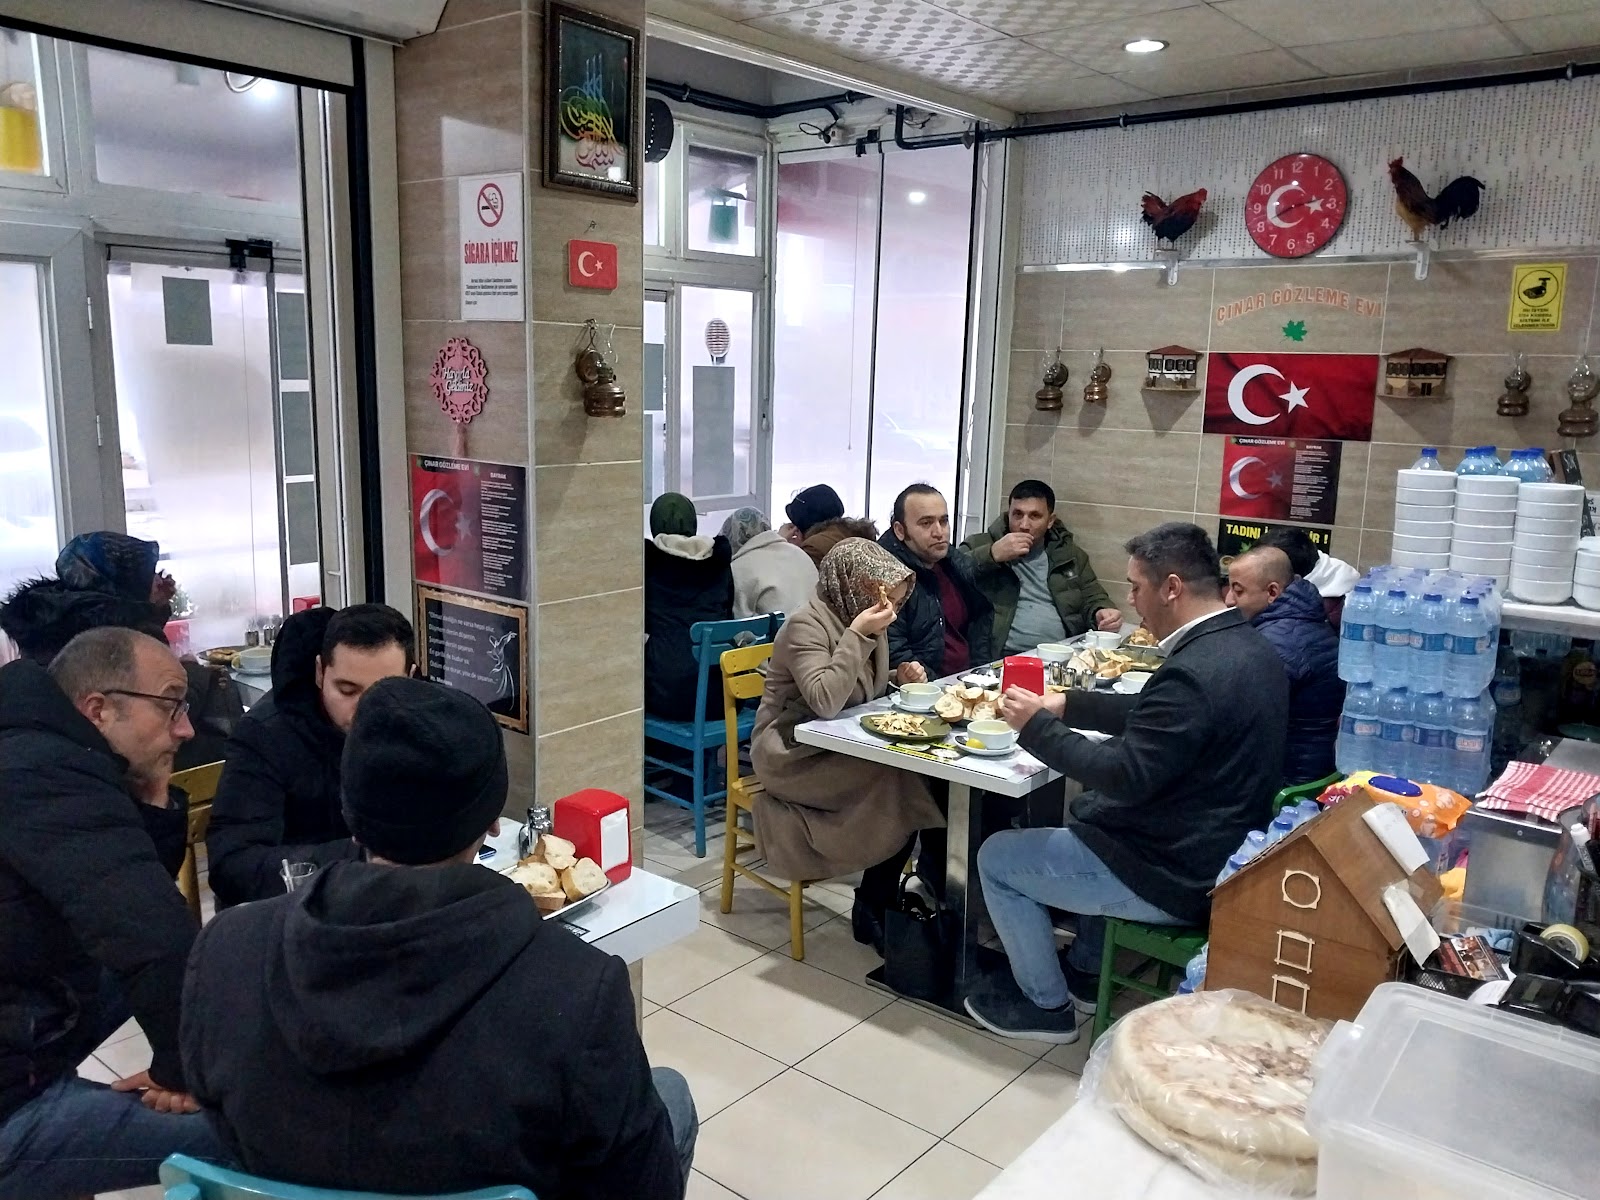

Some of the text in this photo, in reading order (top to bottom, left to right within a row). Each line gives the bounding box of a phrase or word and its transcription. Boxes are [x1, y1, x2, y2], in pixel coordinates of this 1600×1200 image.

[1292, 162, 1303, 173] 12
[1314, 166, 1319, 176] 1
[1274, 168, 1284, 179] 11
[1260, 184, 1271, 195] 10
[1324, 179, 1333, 190] 2
[1253, 203, 1262, 214] 9
[1328, 198, 1337, 209] 3
[1257, 222, 1265, 232] 8
[1321, 218, 1330, 229] 4
[1269, 235, 1277, 245] 7
[1306, 233, 1315, 243] 5
[1287, 239, 1295, 250] 6
[464, 239, 518, 266] SİGARA İÇİLMEZ
[1216, 292, 1265, 326] ÇINAR
[1272, 283, 1349, 309] GÖZLEME
[424, 460, 438, 468] ÇINAR
[439, 462, 460, 470] GÖZLEME
[1226, 524, 1261, 539] TADINI
